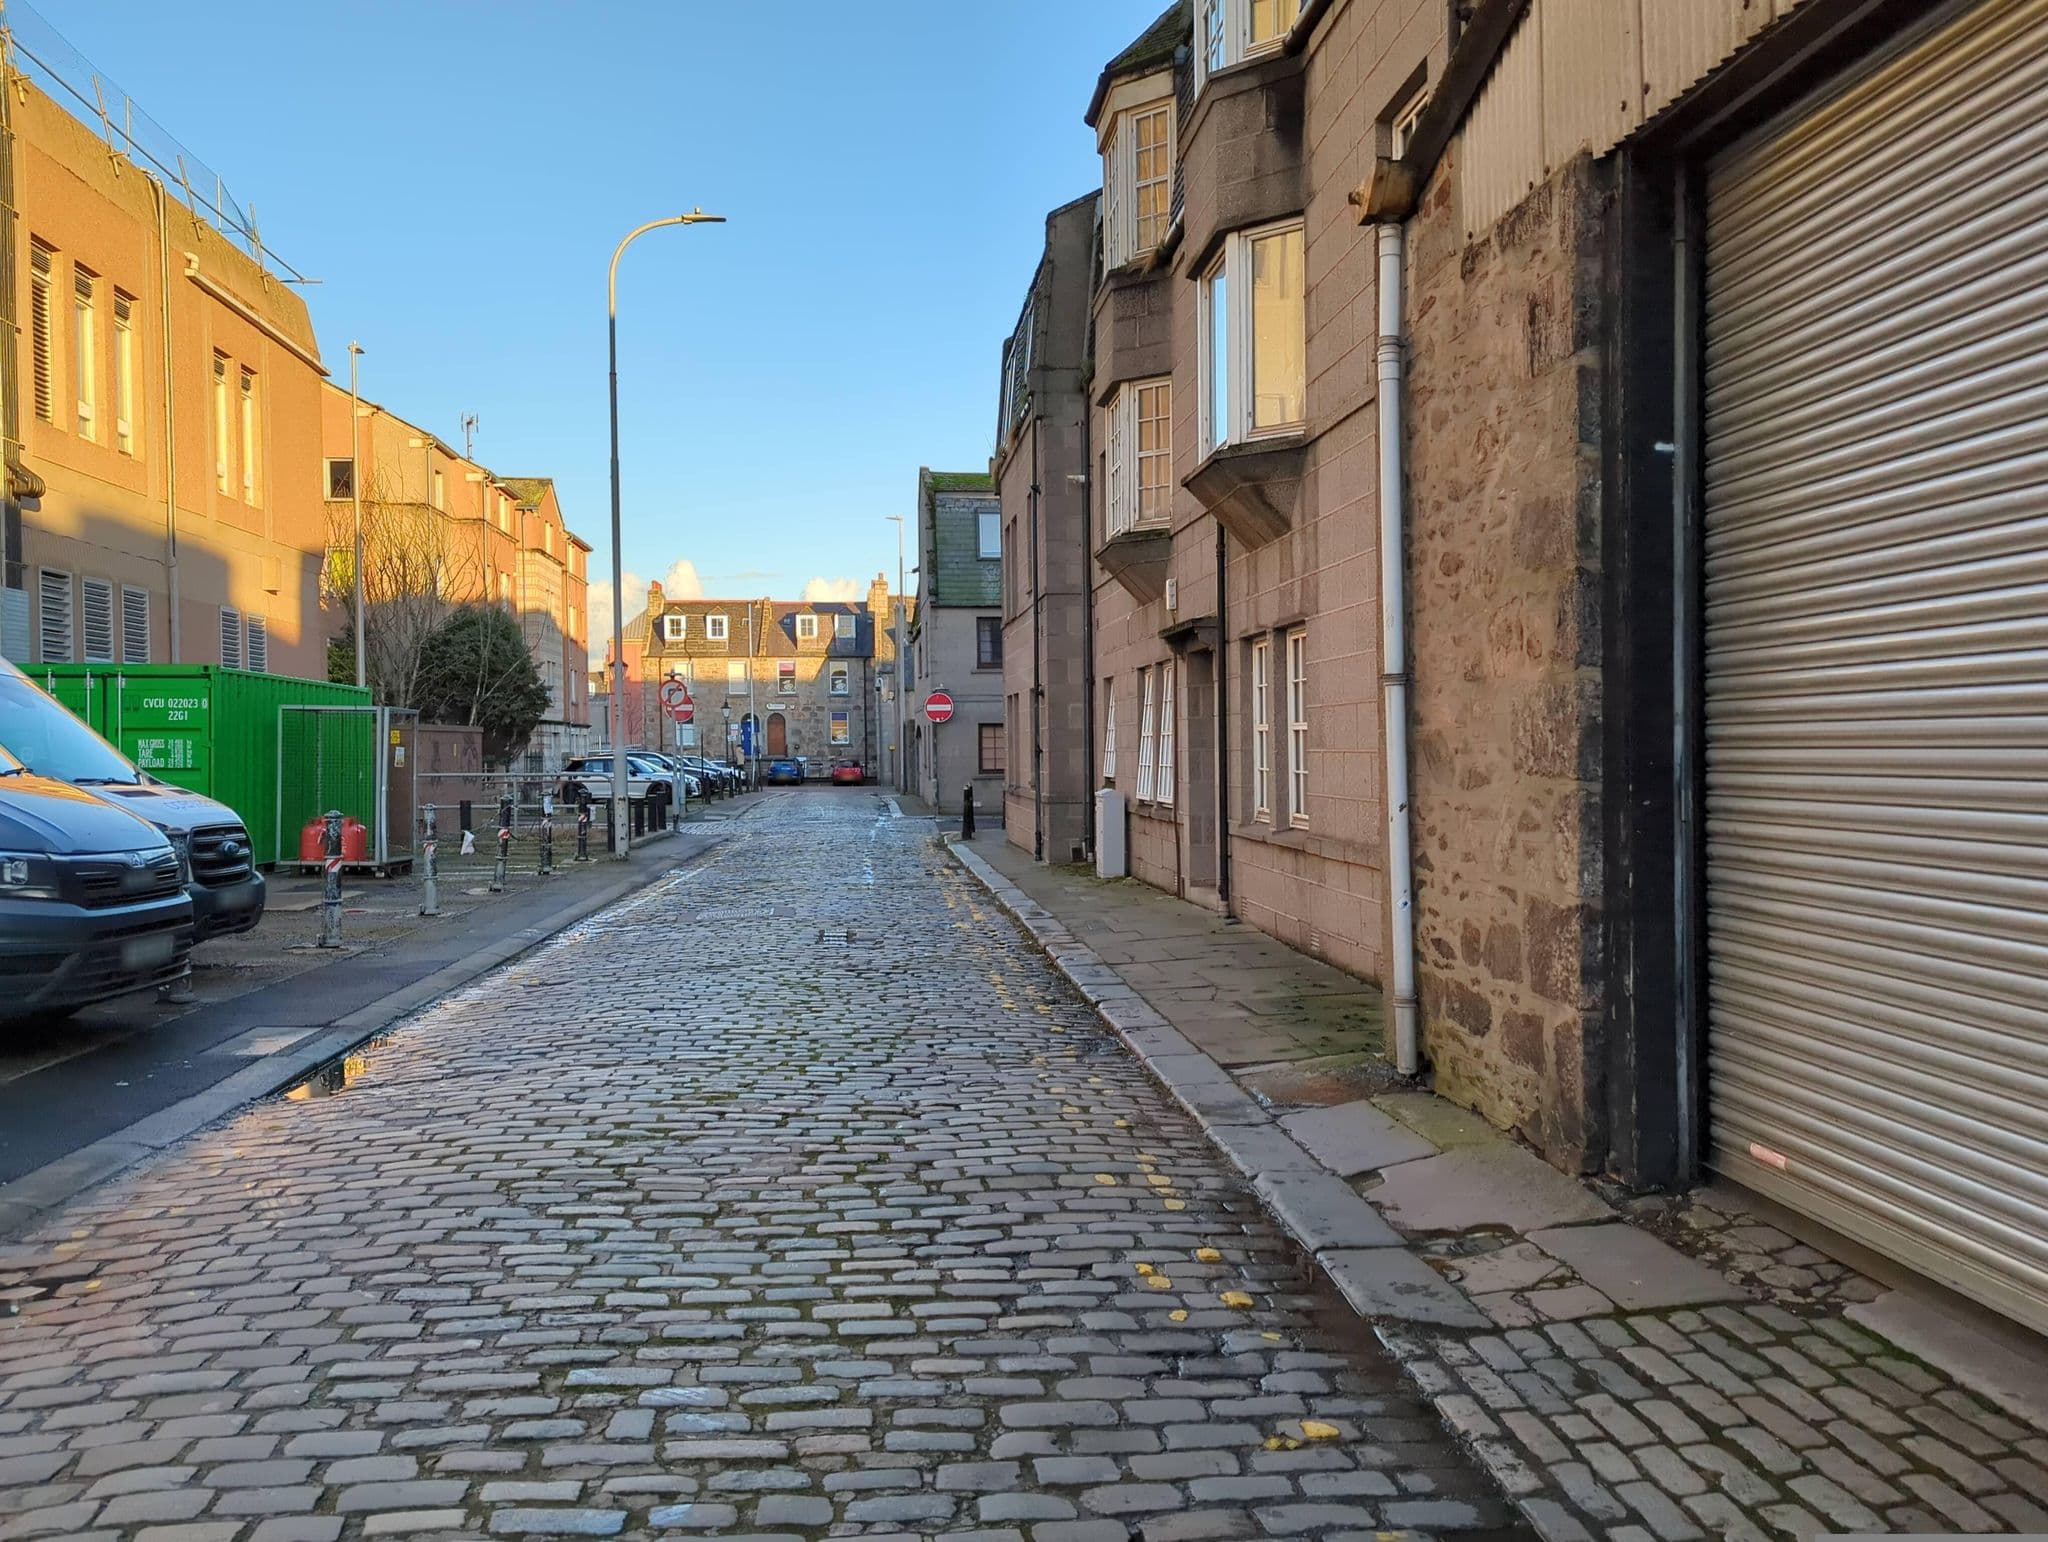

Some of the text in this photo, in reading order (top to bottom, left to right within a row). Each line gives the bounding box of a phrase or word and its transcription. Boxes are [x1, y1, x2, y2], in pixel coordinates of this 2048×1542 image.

[143, 698, 164, 708] CVCU
[168, 698, 198, 708] 022023
[168, 711, 188, 720] 22G1
[138, 758, 164, 768] PAYLOAD
